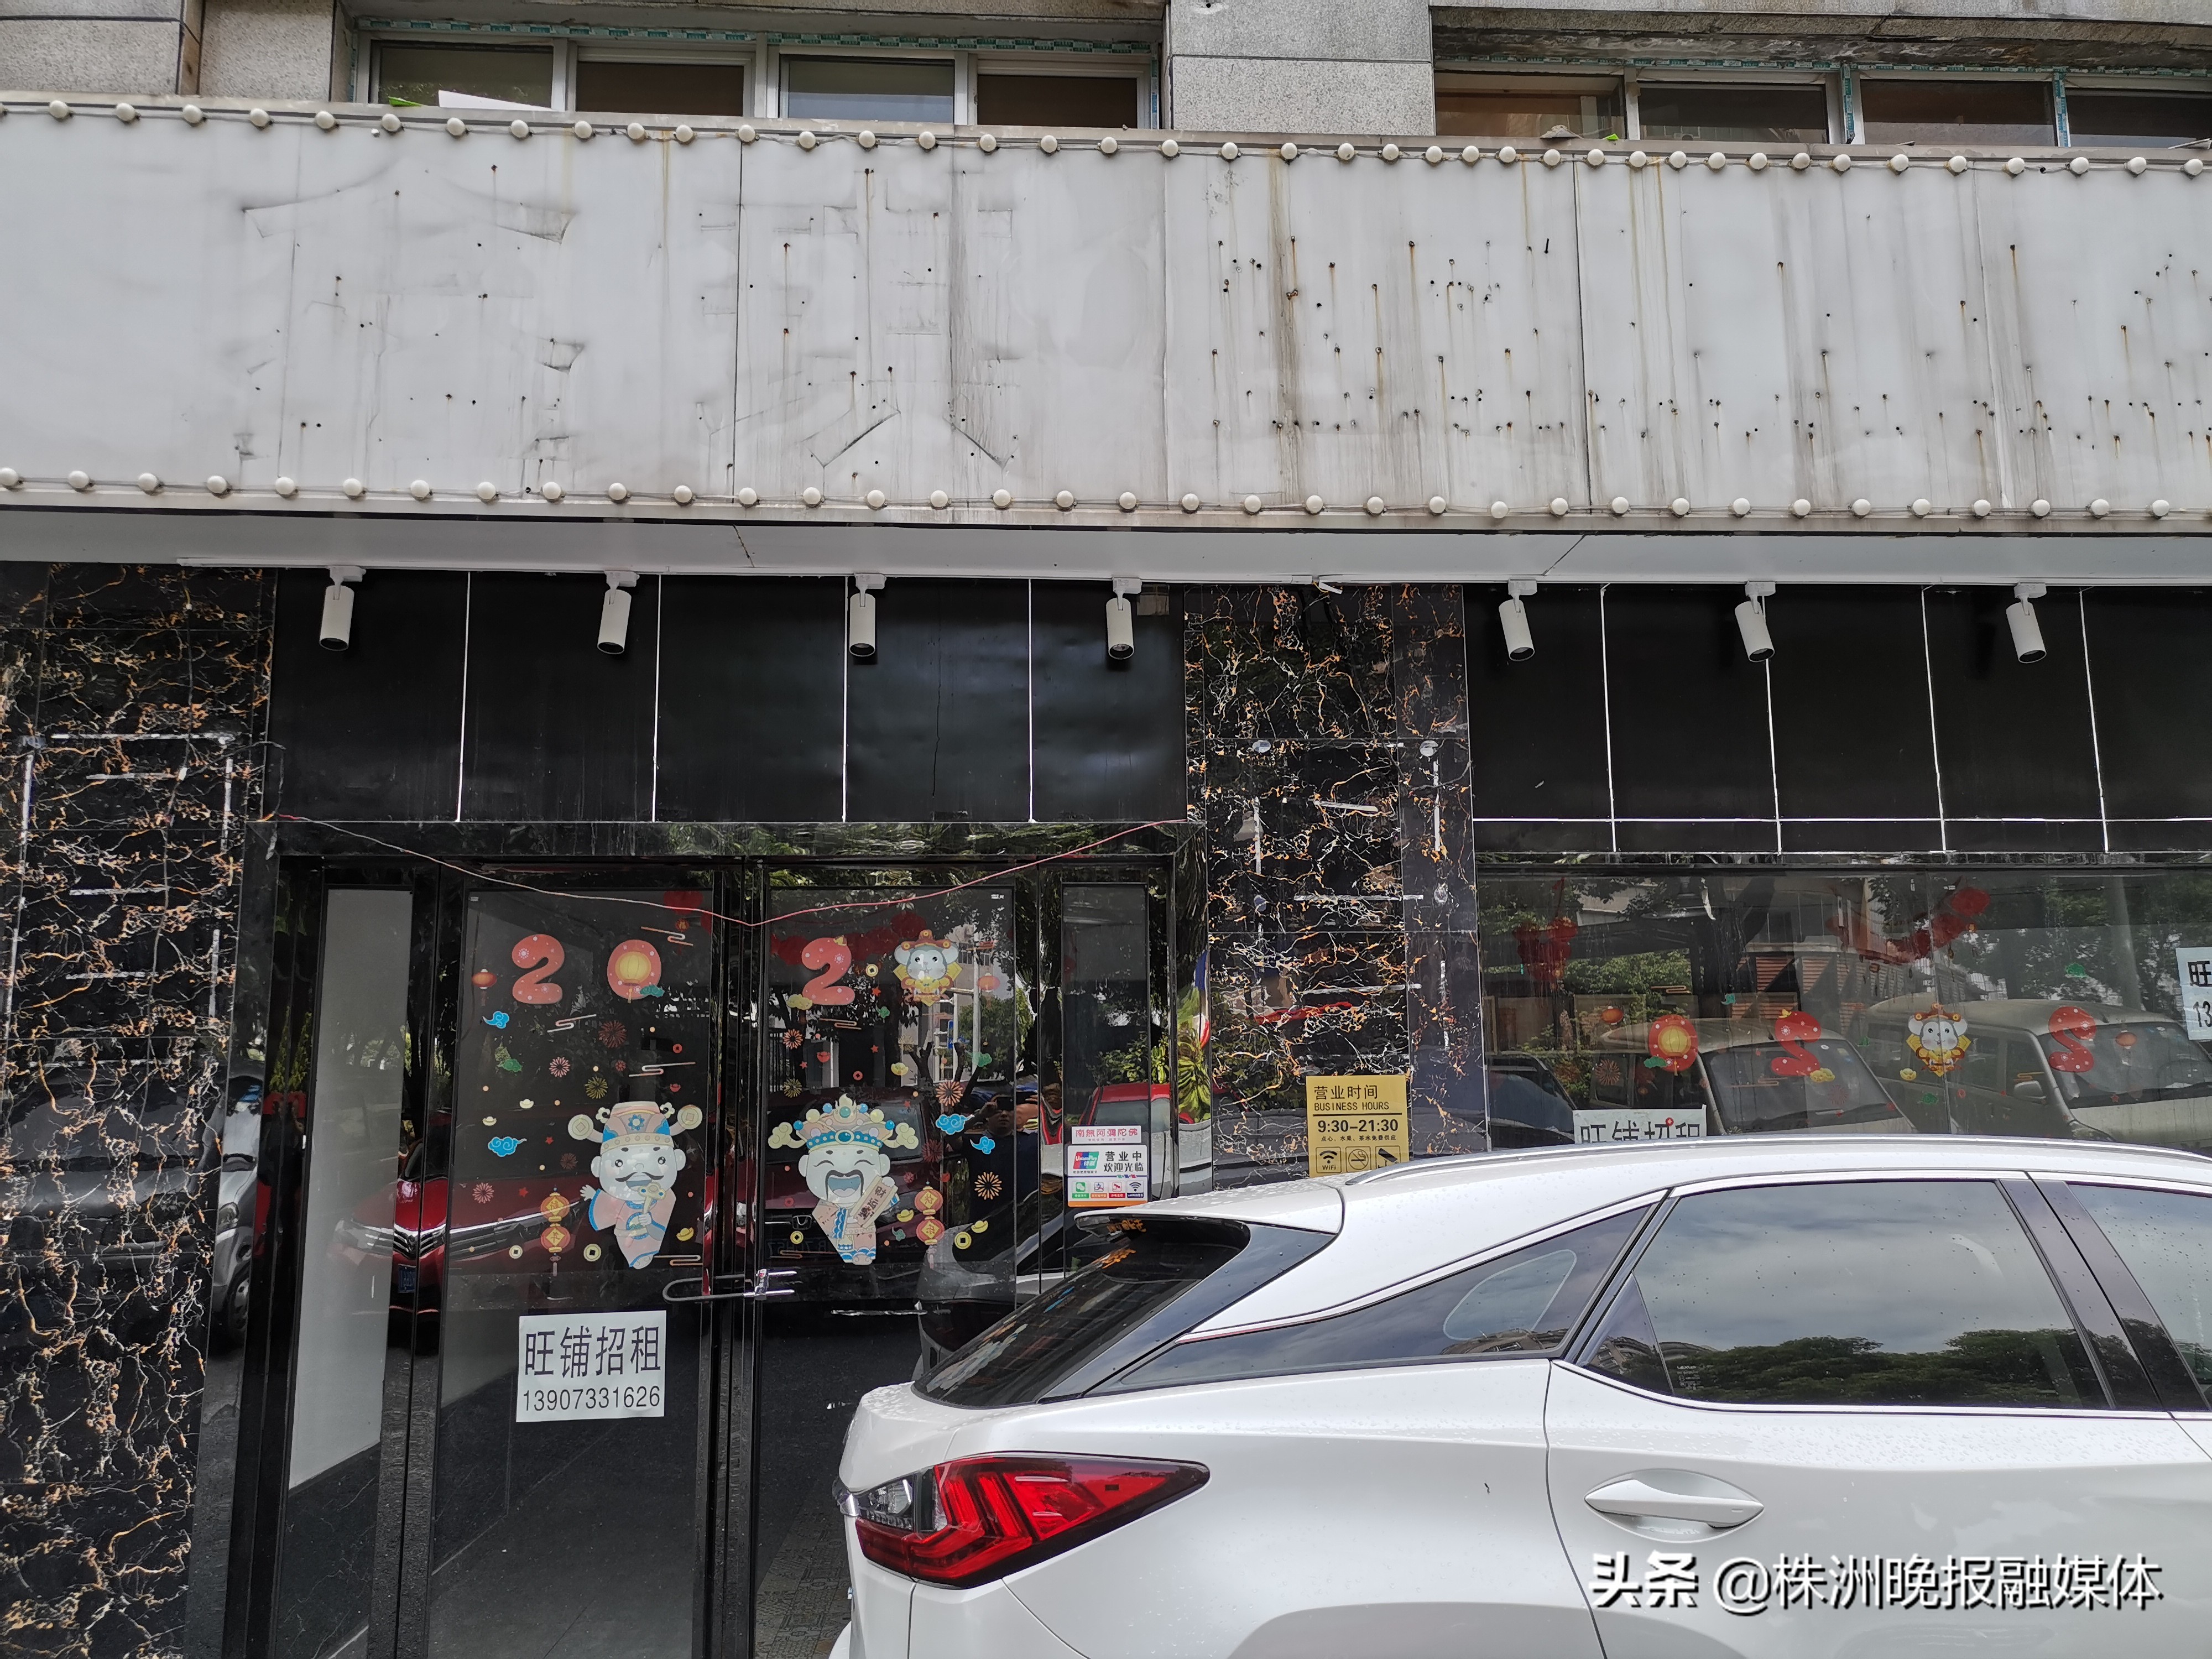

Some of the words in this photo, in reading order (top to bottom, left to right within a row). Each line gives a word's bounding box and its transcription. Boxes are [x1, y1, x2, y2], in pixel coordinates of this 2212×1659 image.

[512, 934, 565, 1004] 2
[801, 937, 855, 1005] 2
[1314, 1084, 1378, 1100] 营业时间
[1314, 1102, 1358, 1111] BUSINESS
[1362, 1102, 1389, 1110] HOURS
[1317, 1119, 1399, 1133] 9:30-21:30
[1105, 1151, 1142, 1161] 营业中
[1103, 1162, 1144, 1172] 欢迎光临
[524, 1325, 661, 1379] 旺铺招租
[523, 1385, 660, 1412] 13907331626
